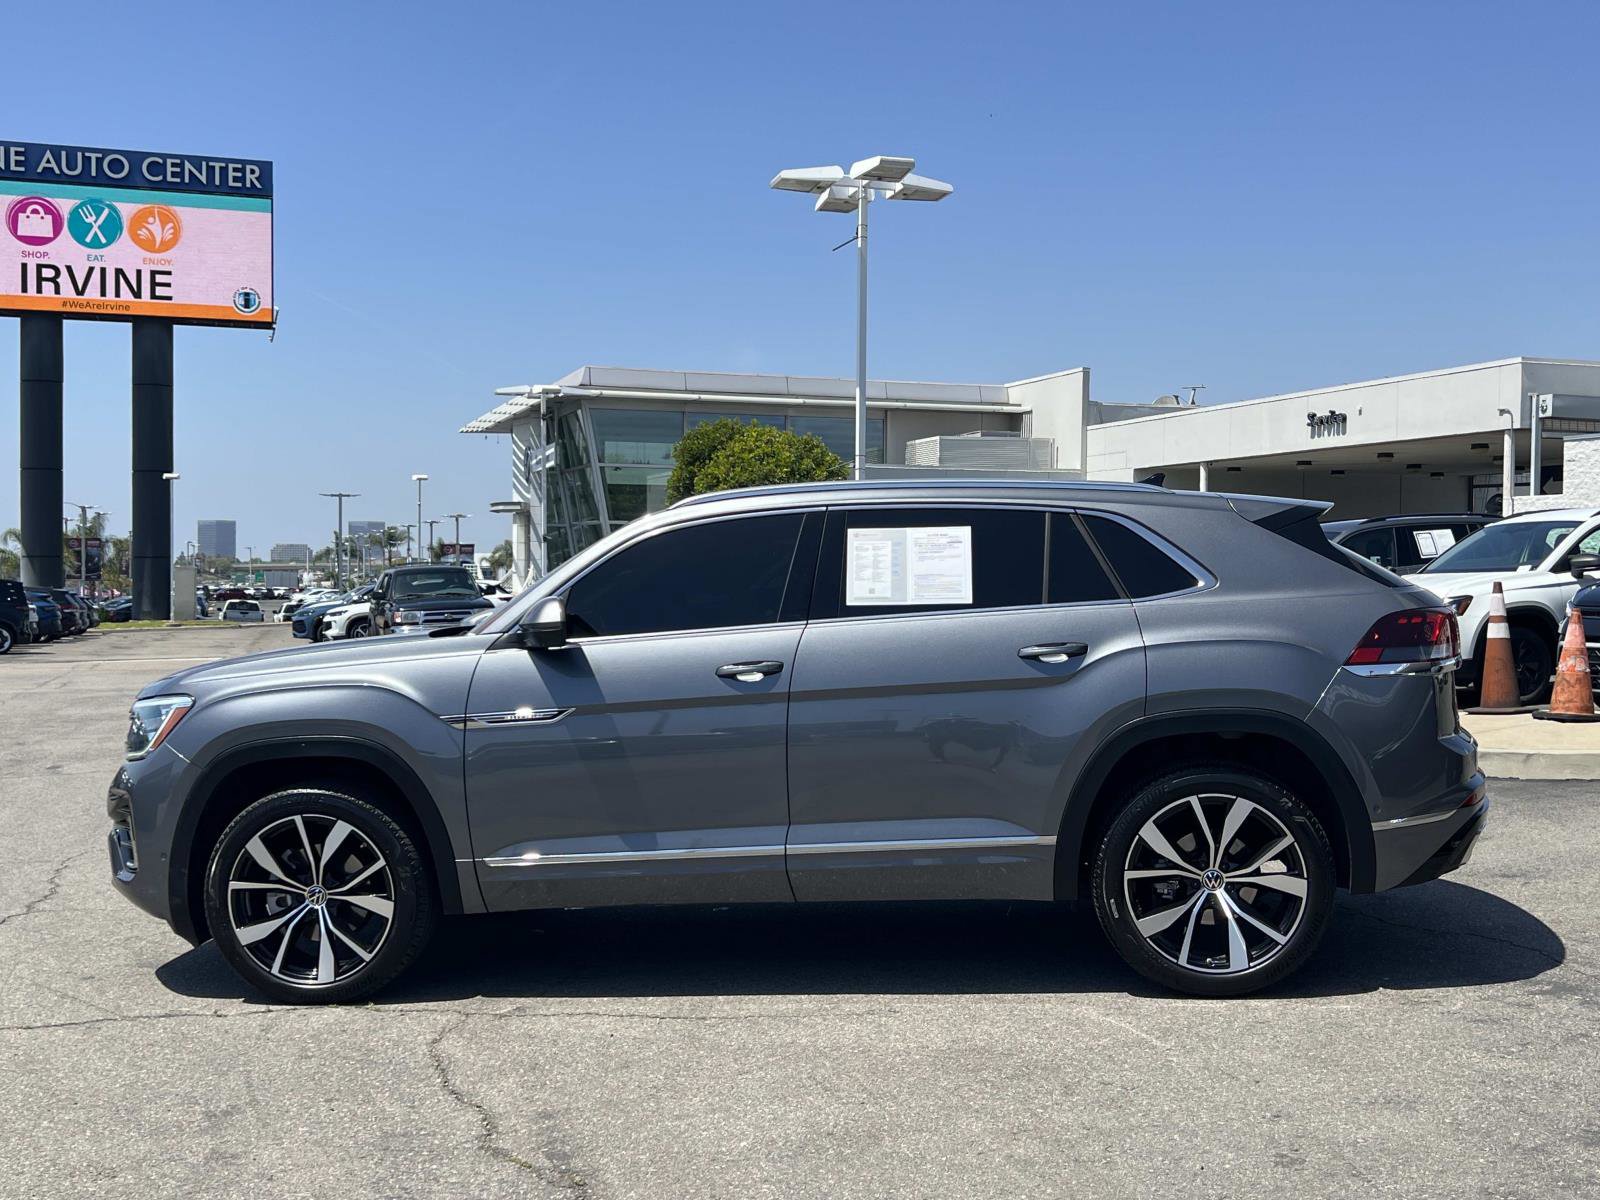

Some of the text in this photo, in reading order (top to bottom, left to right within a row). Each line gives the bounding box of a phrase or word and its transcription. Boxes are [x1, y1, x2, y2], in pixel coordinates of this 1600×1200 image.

[37, 149, 130, 179] AUTO
[142, 157, 262, 189] CENTER
[21, 250, 173, 266] SHOP. EAT. ENJOY.
[21, 262, 173, 301] IRVINE
[61, 300, 131, 312] #WeAreIrvine
